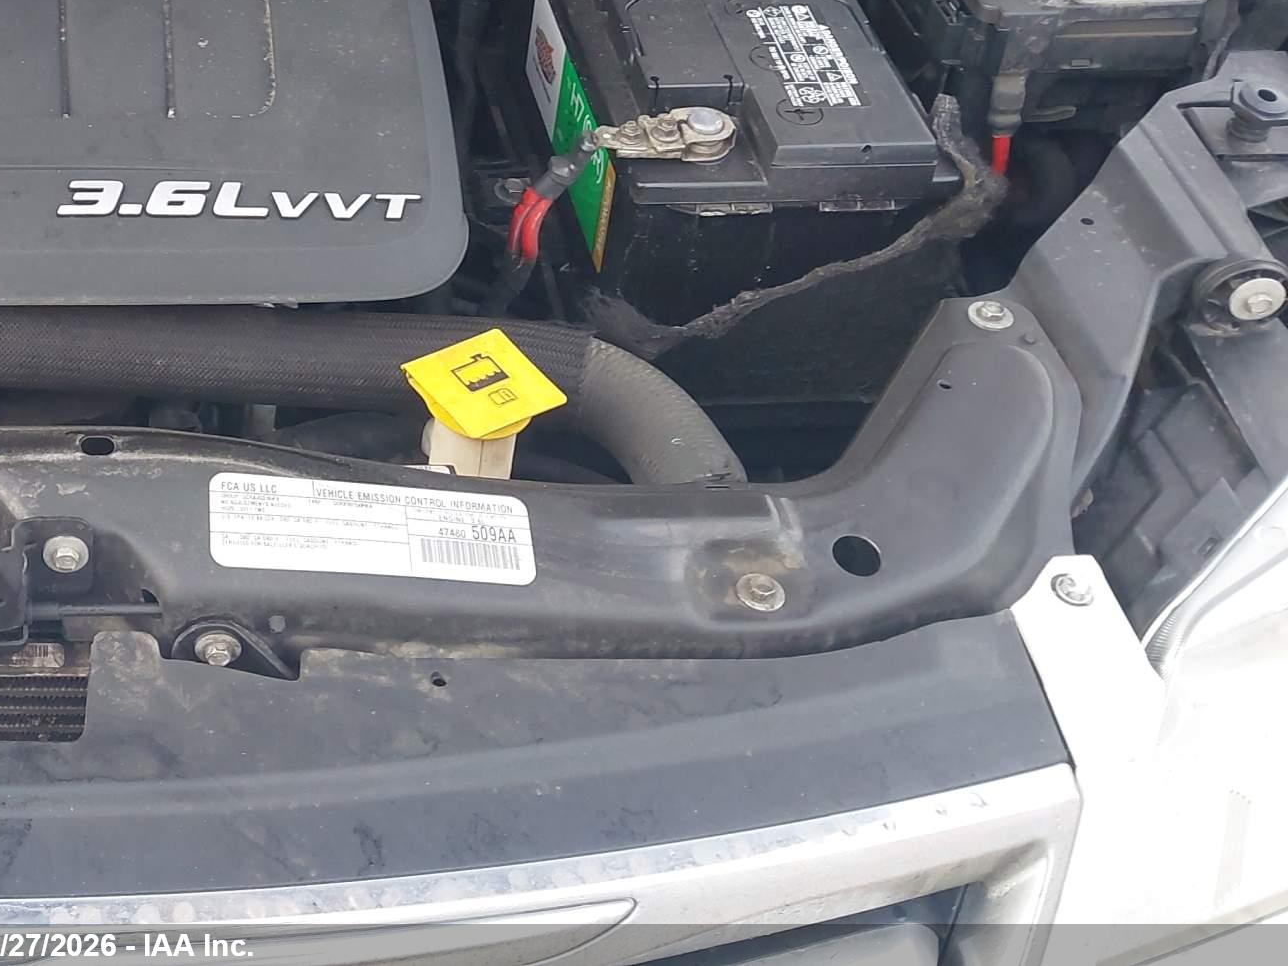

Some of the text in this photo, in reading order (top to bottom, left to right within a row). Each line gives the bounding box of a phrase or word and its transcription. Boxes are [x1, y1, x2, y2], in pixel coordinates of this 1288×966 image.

[221, 482, 278, 494] FCA US LLC
[316, 488, 354, 500] VEHICLE
[357, 491, 402, 504] EMISSION
[404, 496, 448, 508] CONTROL
[450, 500, 514, 514] INFORMATION
[471, 524, 517, 543] 509AA
